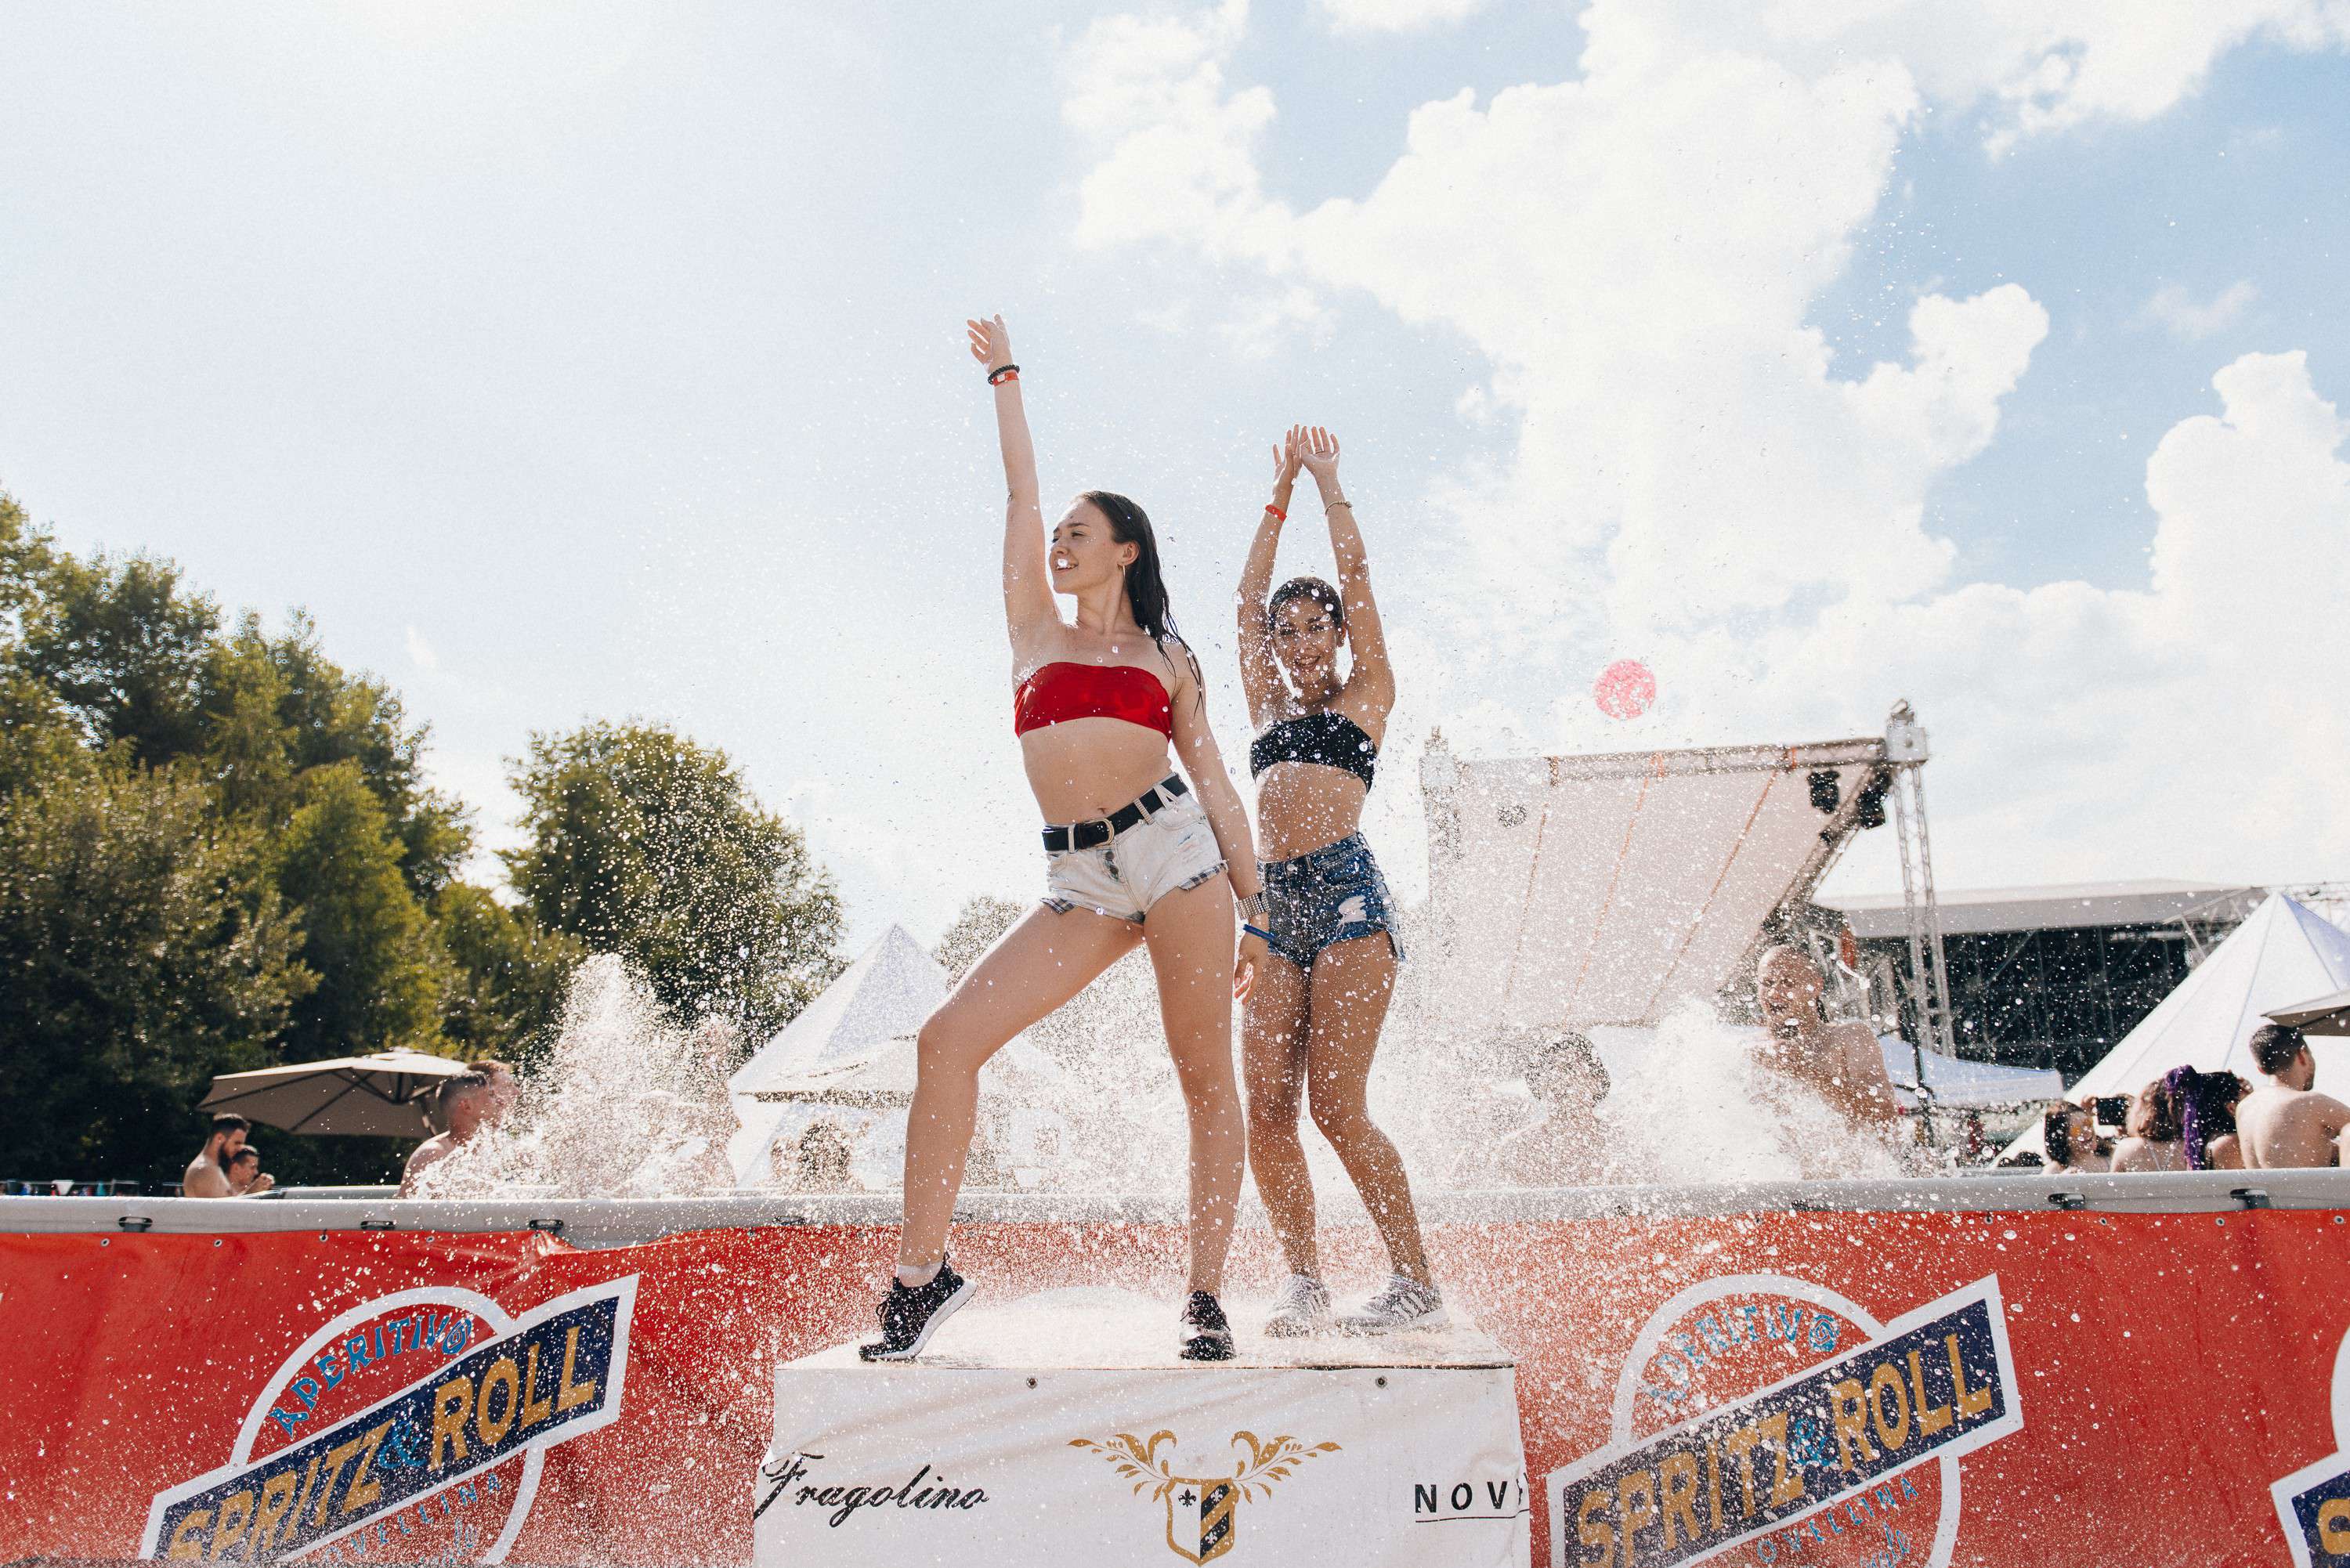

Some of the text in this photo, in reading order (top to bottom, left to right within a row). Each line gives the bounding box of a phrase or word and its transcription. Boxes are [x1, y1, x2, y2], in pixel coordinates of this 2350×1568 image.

[269, 1313, 473, 1438] APERITIVO
[430, 1325, 596, 1472] ROLL
[754, 1451, 990, 1527] Fragolino
[1578, 1411, 1805, 1568] SPRITZ
[1830, 1333, 1993, 1472] ROLL
